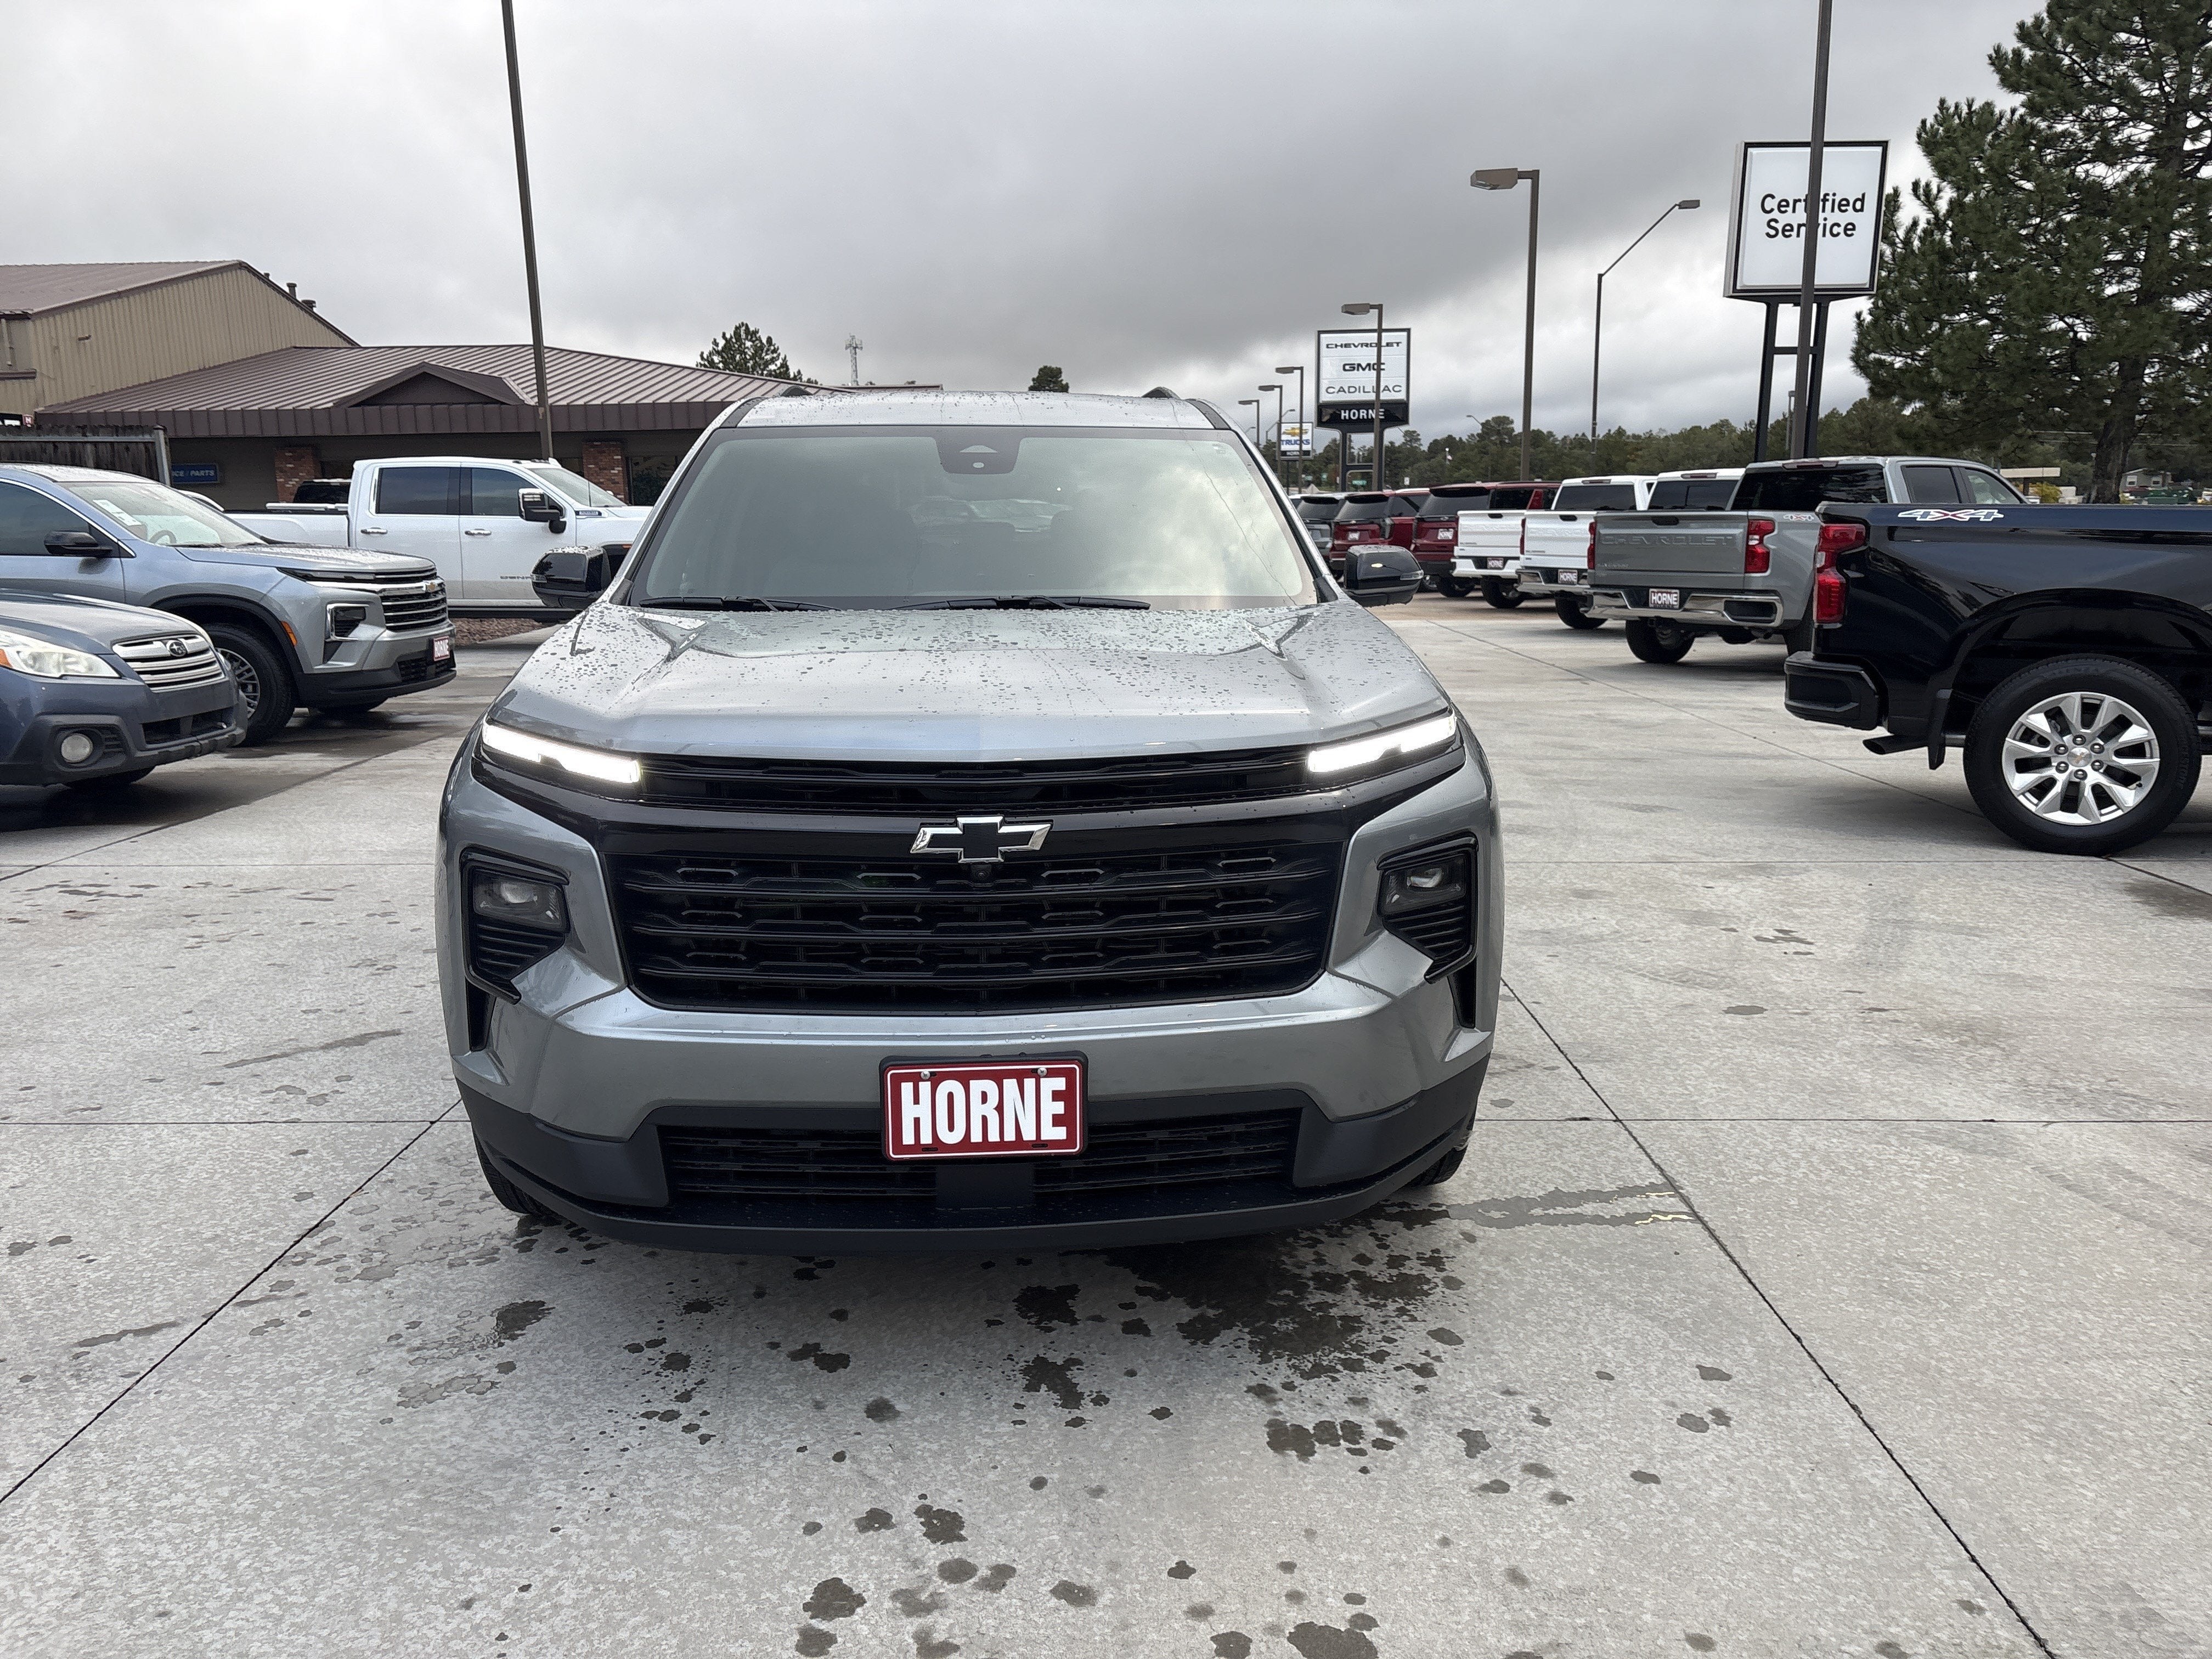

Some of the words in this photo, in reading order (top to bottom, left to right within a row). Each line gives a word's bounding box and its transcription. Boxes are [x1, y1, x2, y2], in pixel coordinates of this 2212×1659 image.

[1760, 191, 1865, 214] Certfied
[1765, 218, 1856, 238] Serice
[1342, 363, 1386, 371] GMC
[1325, 385, 1402, 394] CADILLAC
[1340, 408, 1385, 420] HORNE
[1559, 572, 1577, 582] HORNE
[1651, 592, 1678, 605] HORNE
[901, 1077, 1067, 1146] HORNE
